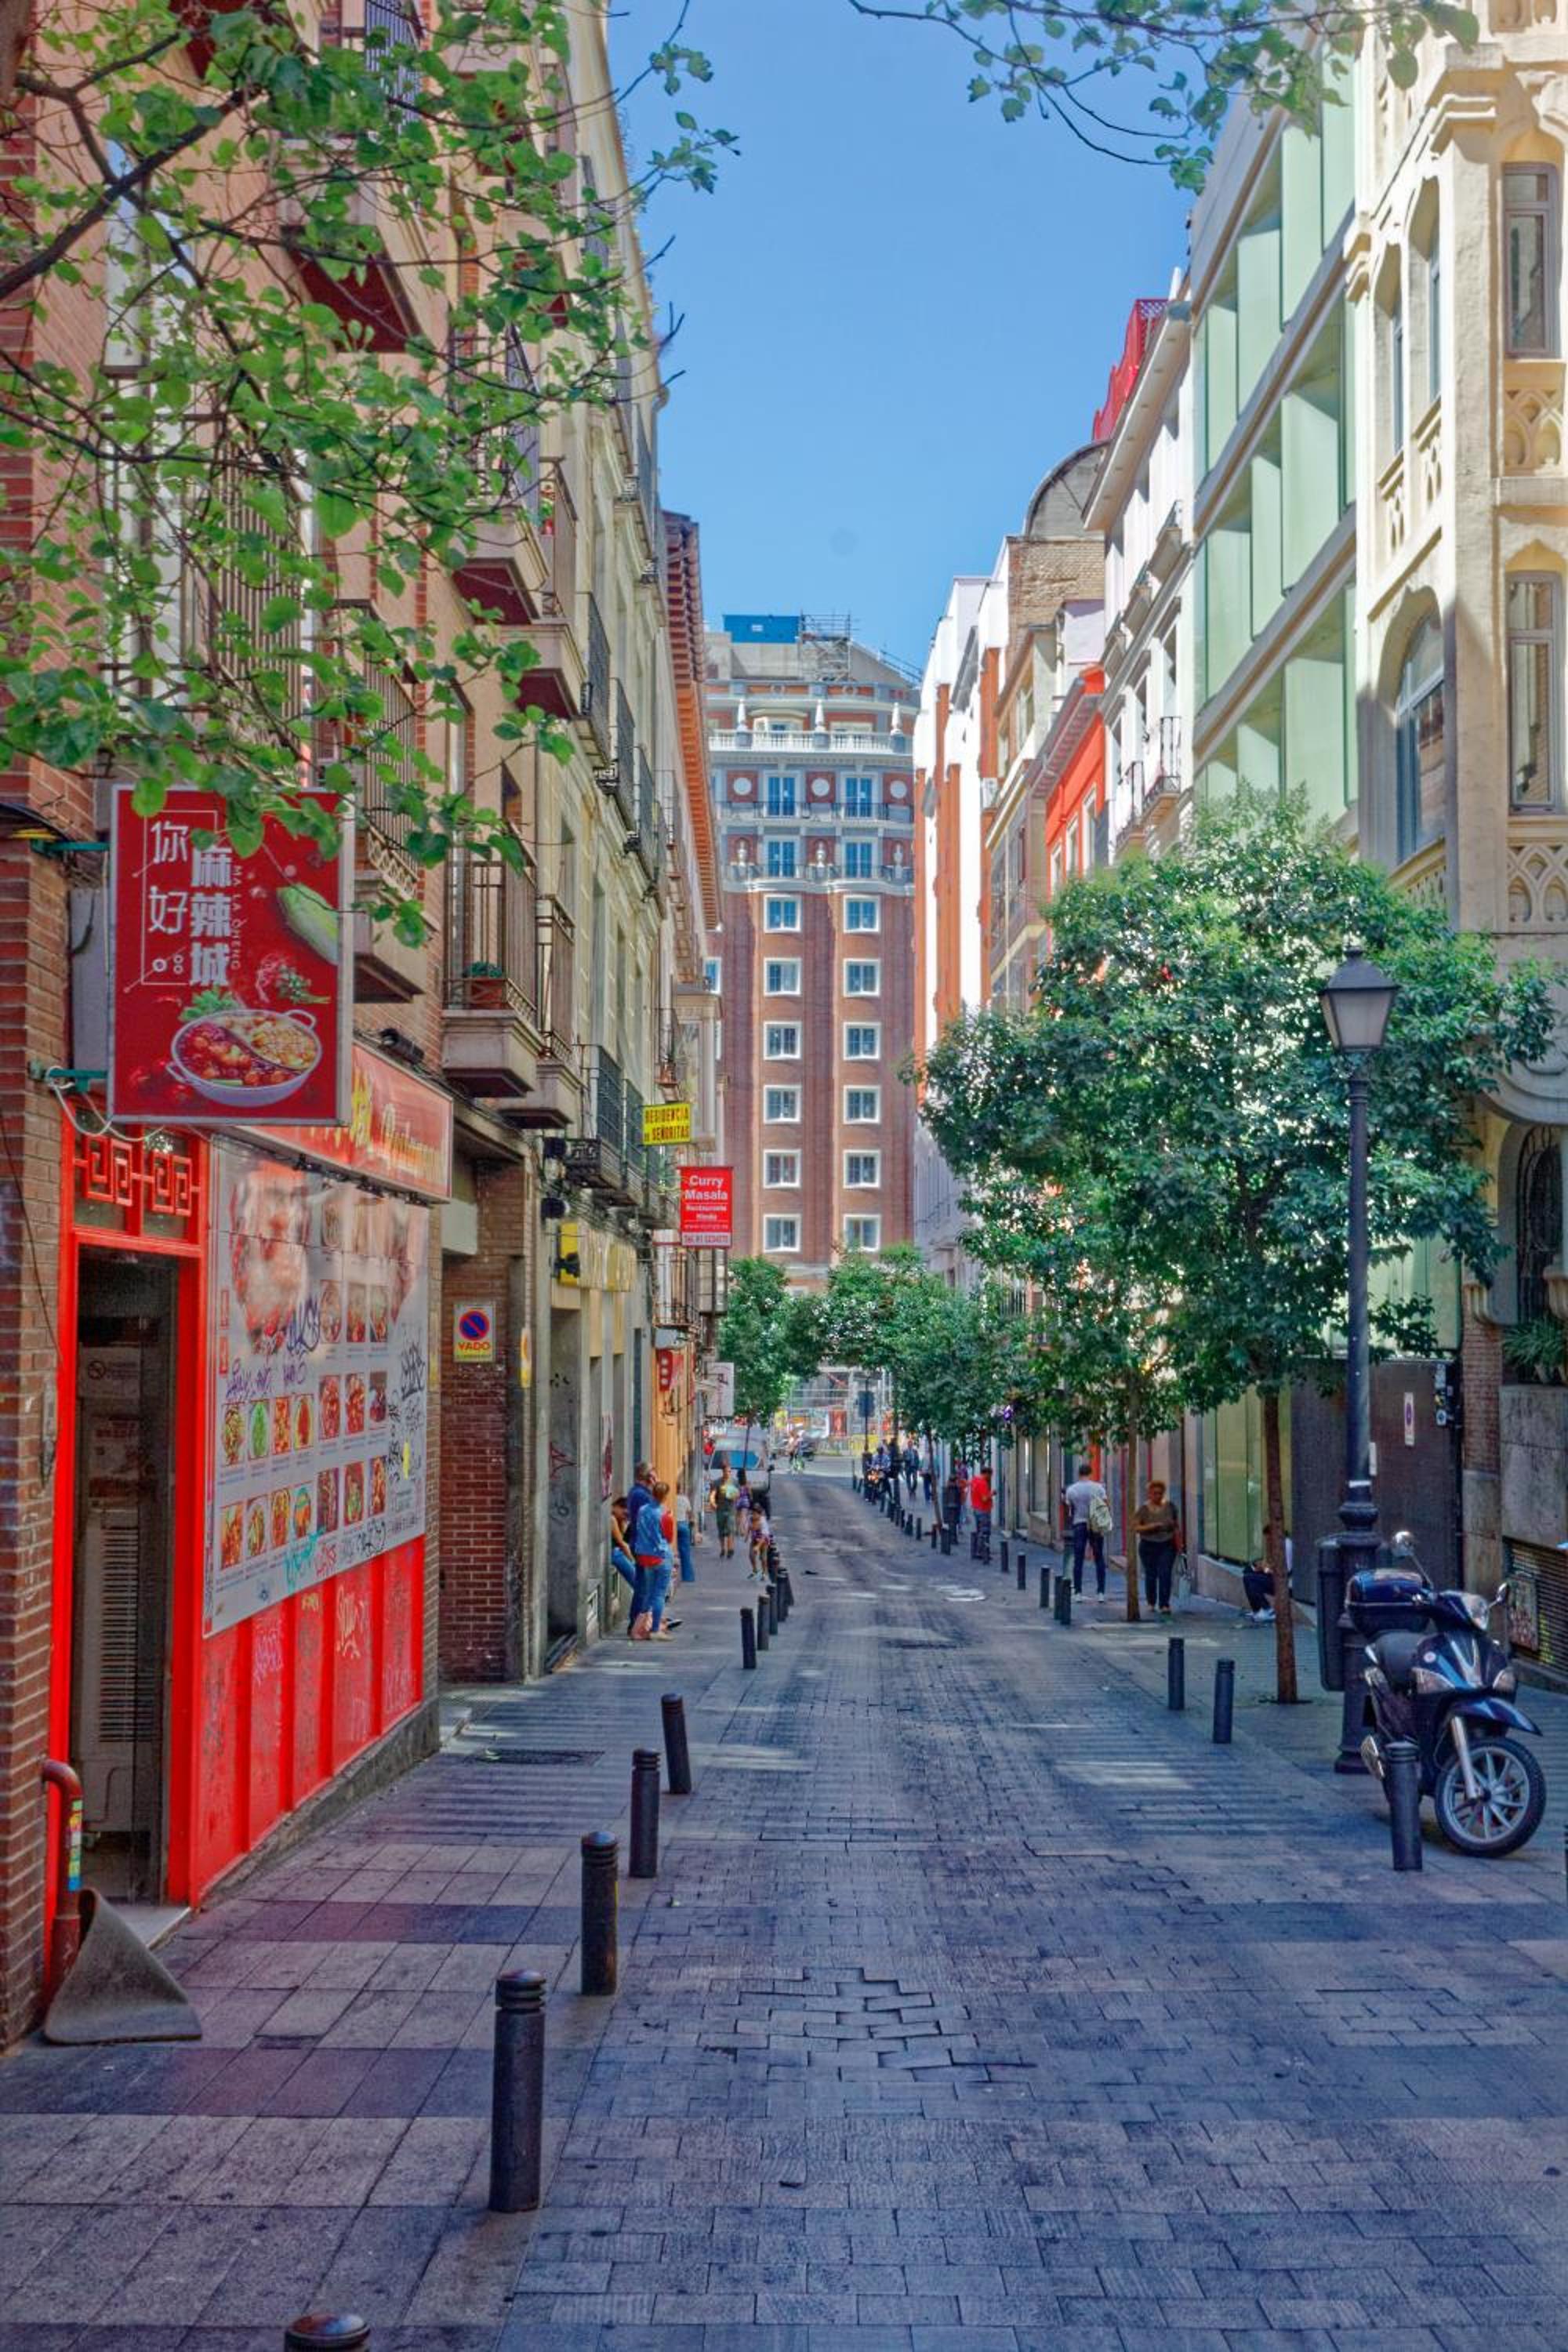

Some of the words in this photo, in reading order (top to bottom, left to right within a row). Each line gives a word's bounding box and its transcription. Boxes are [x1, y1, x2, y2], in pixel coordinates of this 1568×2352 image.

[148, 820, 189, 935] 你好
[231, 865, 242, 886] MA
[231, 894, 242, 912] LA
[190, 844, 233, 986] 麻辣城
[645, 1108, 688, 1124] RESIDENCIA
[652, 1125, 689, 1141] SEÑORITAS
[690, 1175, 723, 1189] Curry
[685, 1189, 728, 1200] Masala
[458, 1341, 490, 1350] VADO
